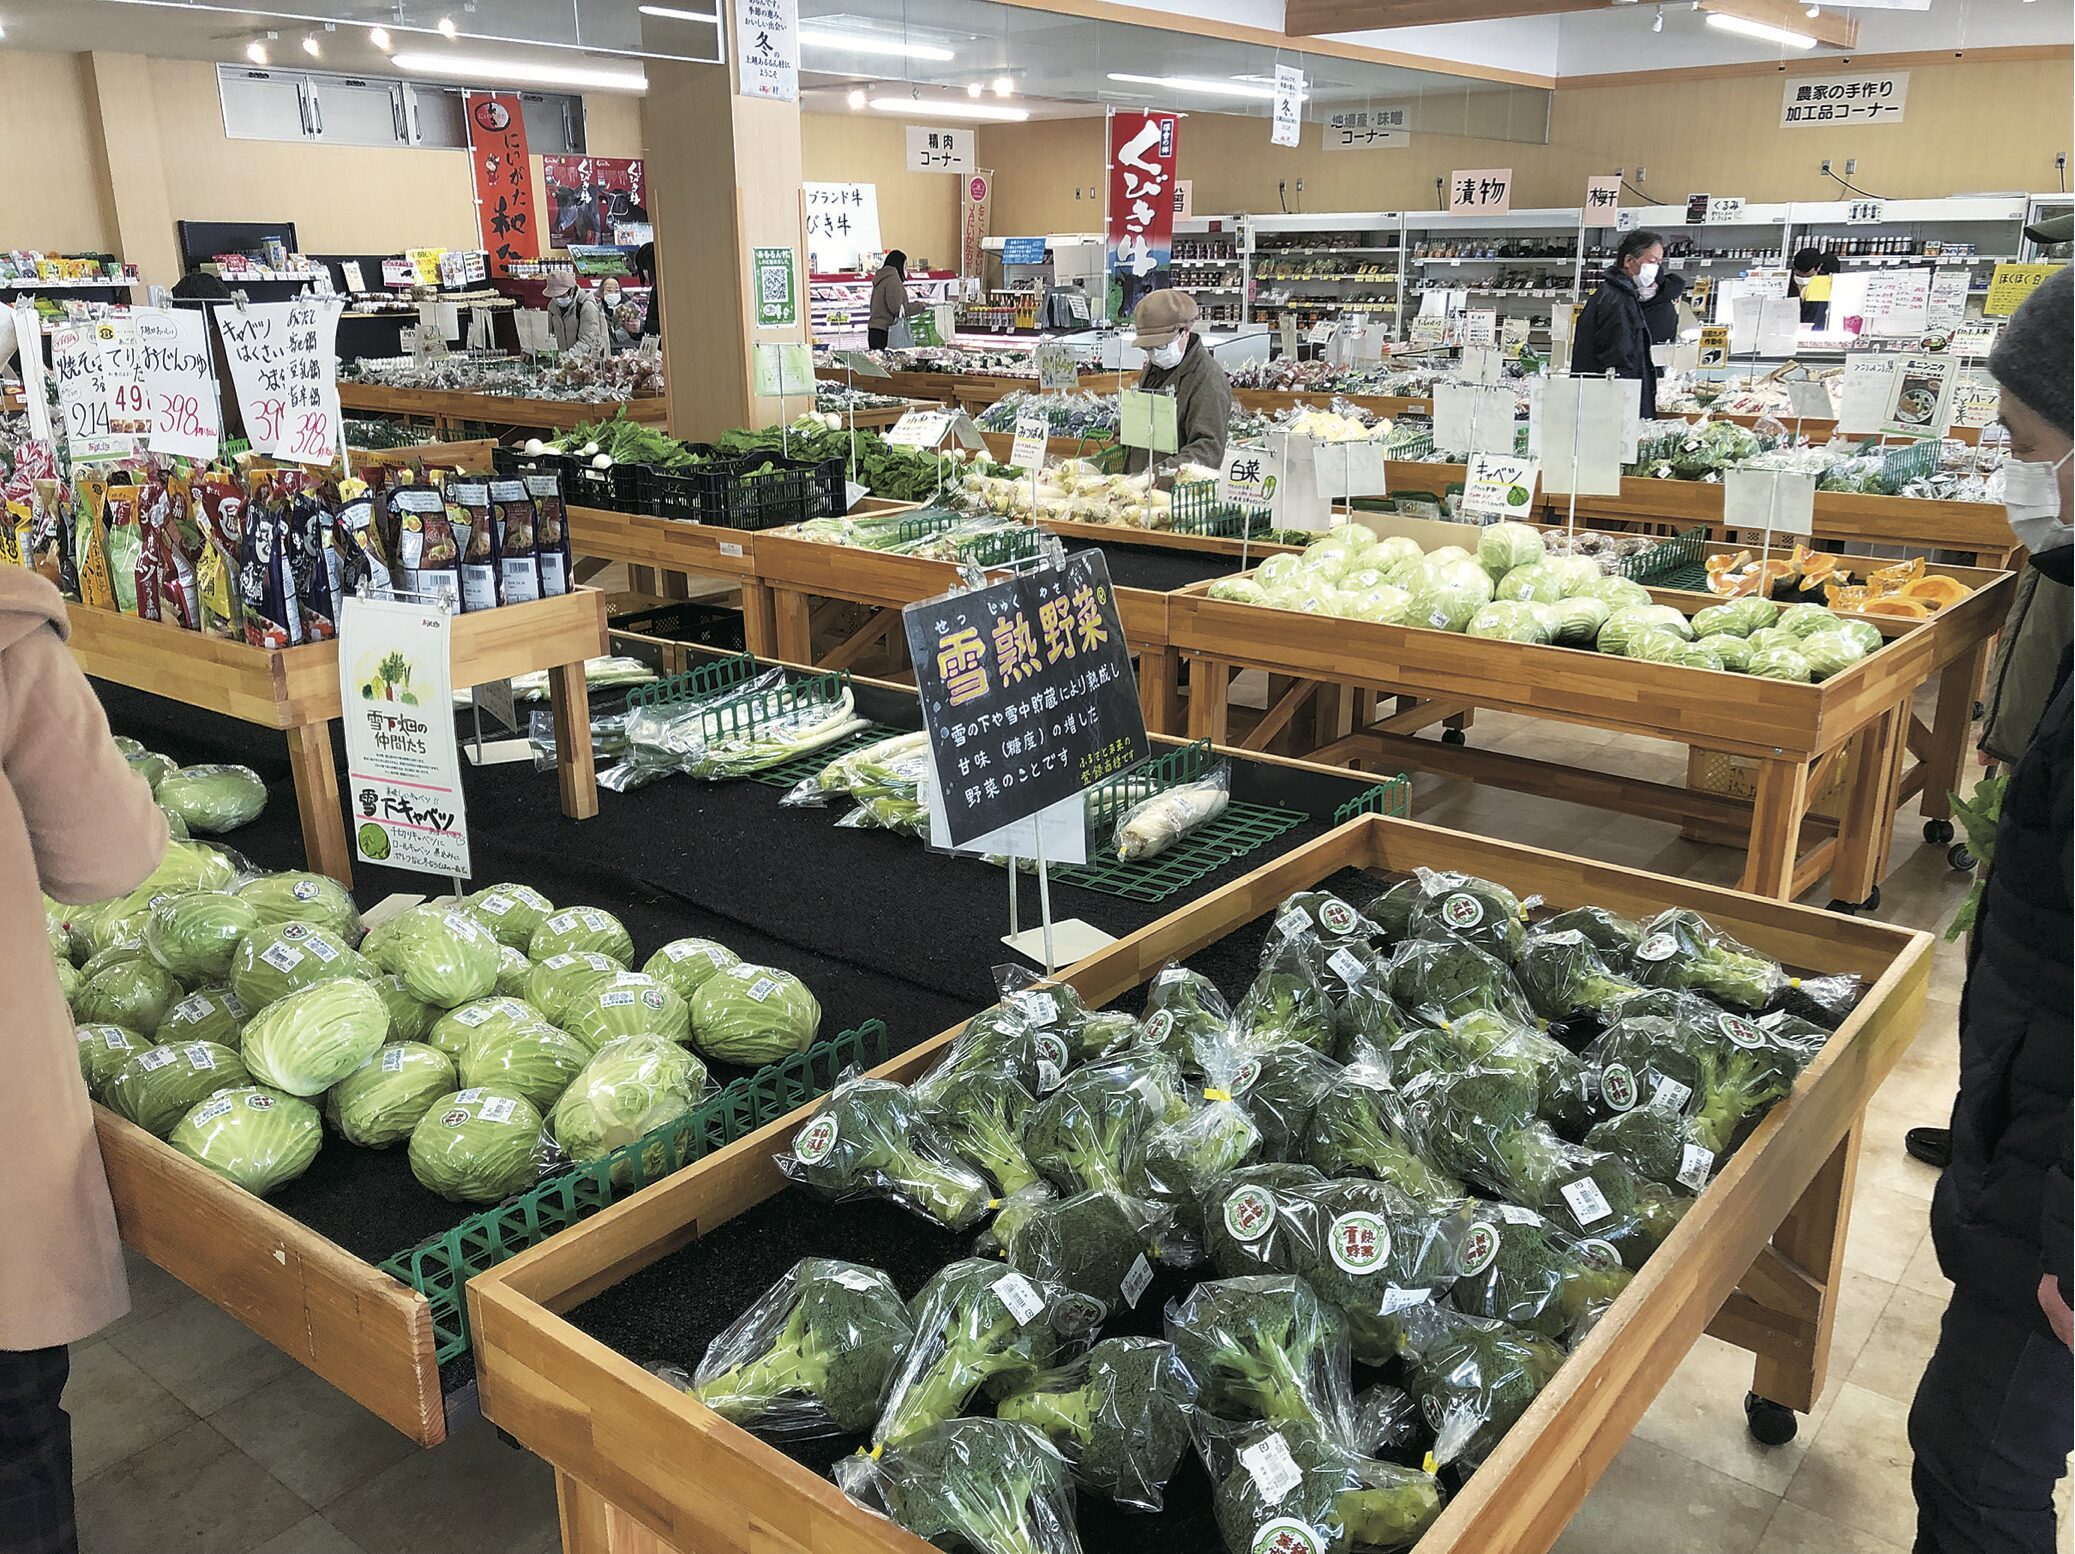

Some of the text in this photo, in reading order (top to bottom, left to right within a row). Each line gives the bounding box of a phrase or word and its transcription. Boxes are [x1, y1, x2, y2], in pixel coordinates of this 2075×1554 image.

[1796, 80, 1894, 102] 農家の手作り
[1331, 110, 1403, 128] 地場産・味噌
[1785, 103, 1900, 122] 加工品コーナー
[928, 133, 954, 150] 精肉
[1341, 129, 1390, 144] コーナー
[503, 133, 527, 206] にいがた
[920, 151, 962, 167] コーナー
[808, 188, 863, 207] ブランド牛
[1114, 119, 1169, 277] くびき牛
[1454, 177, 1506, 205] 漬物
[1588, 187, 1617, 207] 梅干
[1714, 200, 1740, 210] くるみ
[806, 213, 852, 237] びき牛
[222, 318, 272, 342] キャベツ
[141, 345, 208, 380] おでんつゆ
[236, 344, 285, 364] はくさい
[115, 385, 151, 412] 49
[159, 393, 200, 436] 398
[1230, 459, 1260, 483] 白菜
[1476, 460, 1523, 484] キャベツ
[950, 661, 1120, 748] 雪の下や雪中貯蔵により熟成し
[366, 709, 428, 737] 雪下畑の
[375, 731, 427, 754] 仲間たち
[964, 748, 1070, 809] 野菜のことです
[359, 788, 455, 831] 雪下キャベツ
